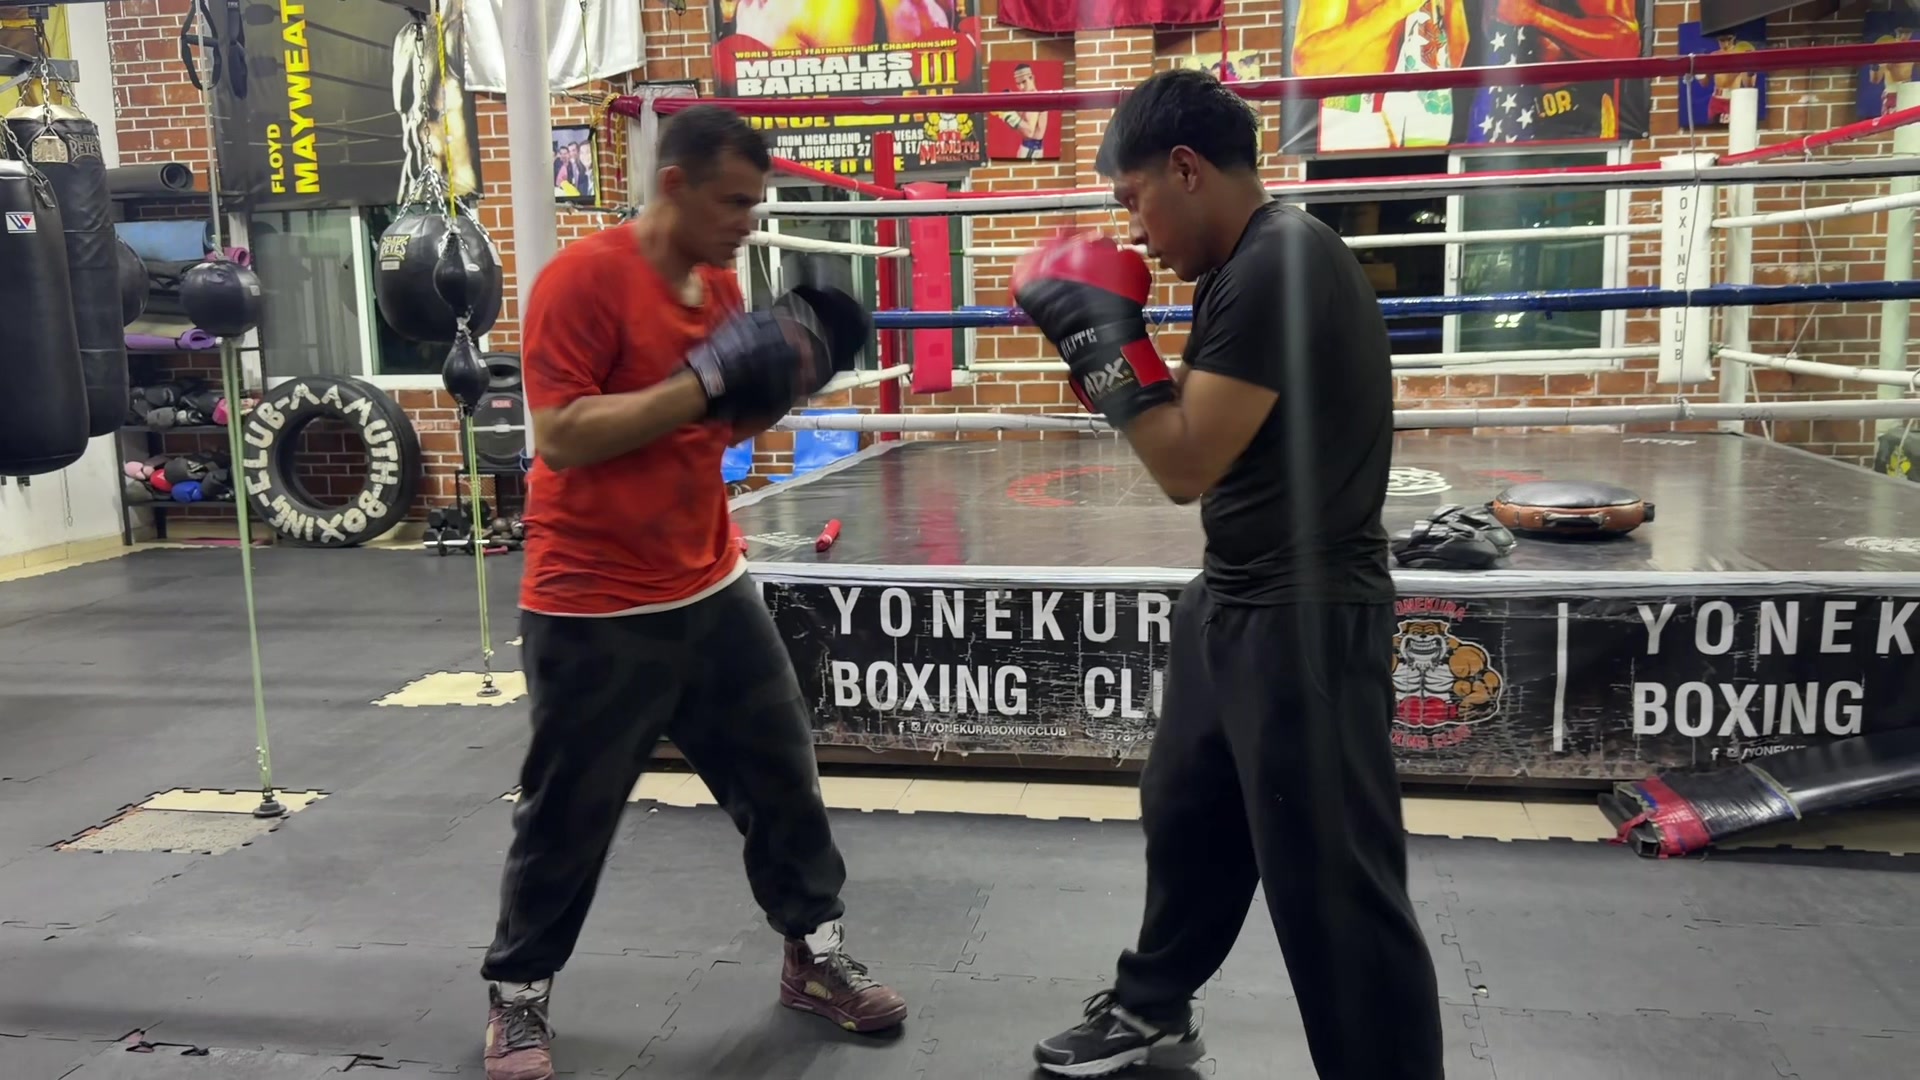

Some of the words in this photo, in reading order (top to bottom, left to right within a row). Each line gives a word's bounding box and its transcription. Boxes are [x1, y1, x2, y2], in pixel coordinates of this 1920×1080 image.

[735, 51, 769, 59] WORLD
[771, 49, 802, 57] SUPER
[805, 44, 879, 55] FEATHERWEIGHT
[882, 39, 957, 51] CHAMPIONSHIP
[735, 52, 913, 79] MORALES
[280, 0, 320, 193] MAYWEAT
[737, 70, 914, 96] BARRERA
[266, 123, 286, 193] FLOYD
[777, 134, 803, 147] FROM
[804, 133, 828, 146] MGM
[829, 132, 861, 145] GRAND
[894, 128, 924, 141] VEGAS
[798, 145, 854, 160] NOVEMBER
[857, 143, 871, 157] 27
[1674, 311, 1684, 361] LUB
[828, 586, 1171, 643] YONEKUR
[1393, 597, 1466, 621] ONEKURA
[1637, 600, 1920, 655] YONEK
[832, 660, 1028, 716] BOXING
[1083, 666, 1164, 718] CL
[1634, 681, 1865, 737] BOXING
